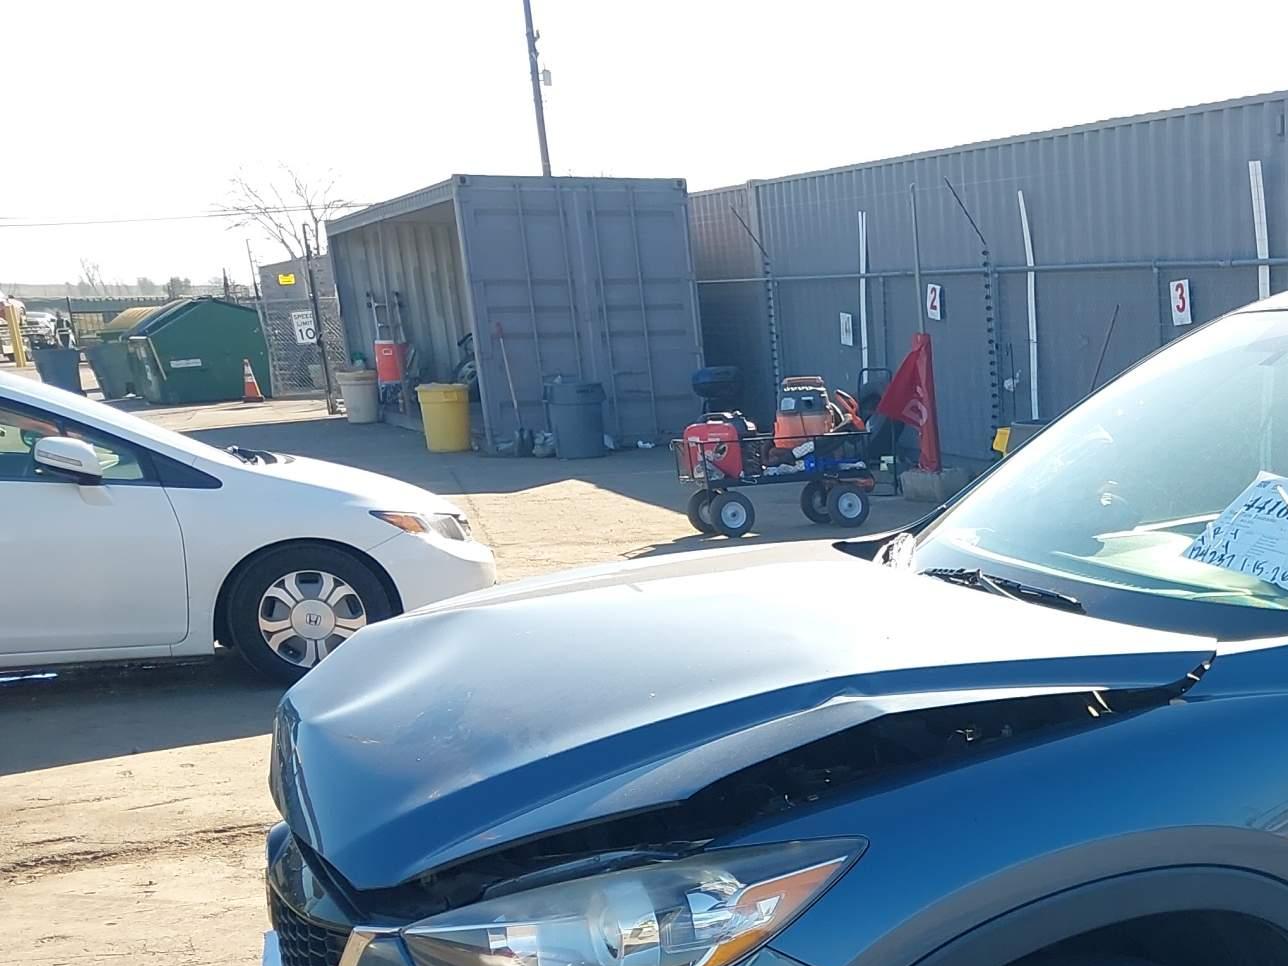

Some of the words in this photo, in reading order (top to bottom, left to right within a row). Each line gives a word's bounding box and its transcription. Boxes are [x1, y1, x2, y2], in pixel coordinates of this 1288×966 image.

[929, 286, 938, 311] 2
[1175, 282, 1186, 313] 3
[299, 327, 316, 340] 10
